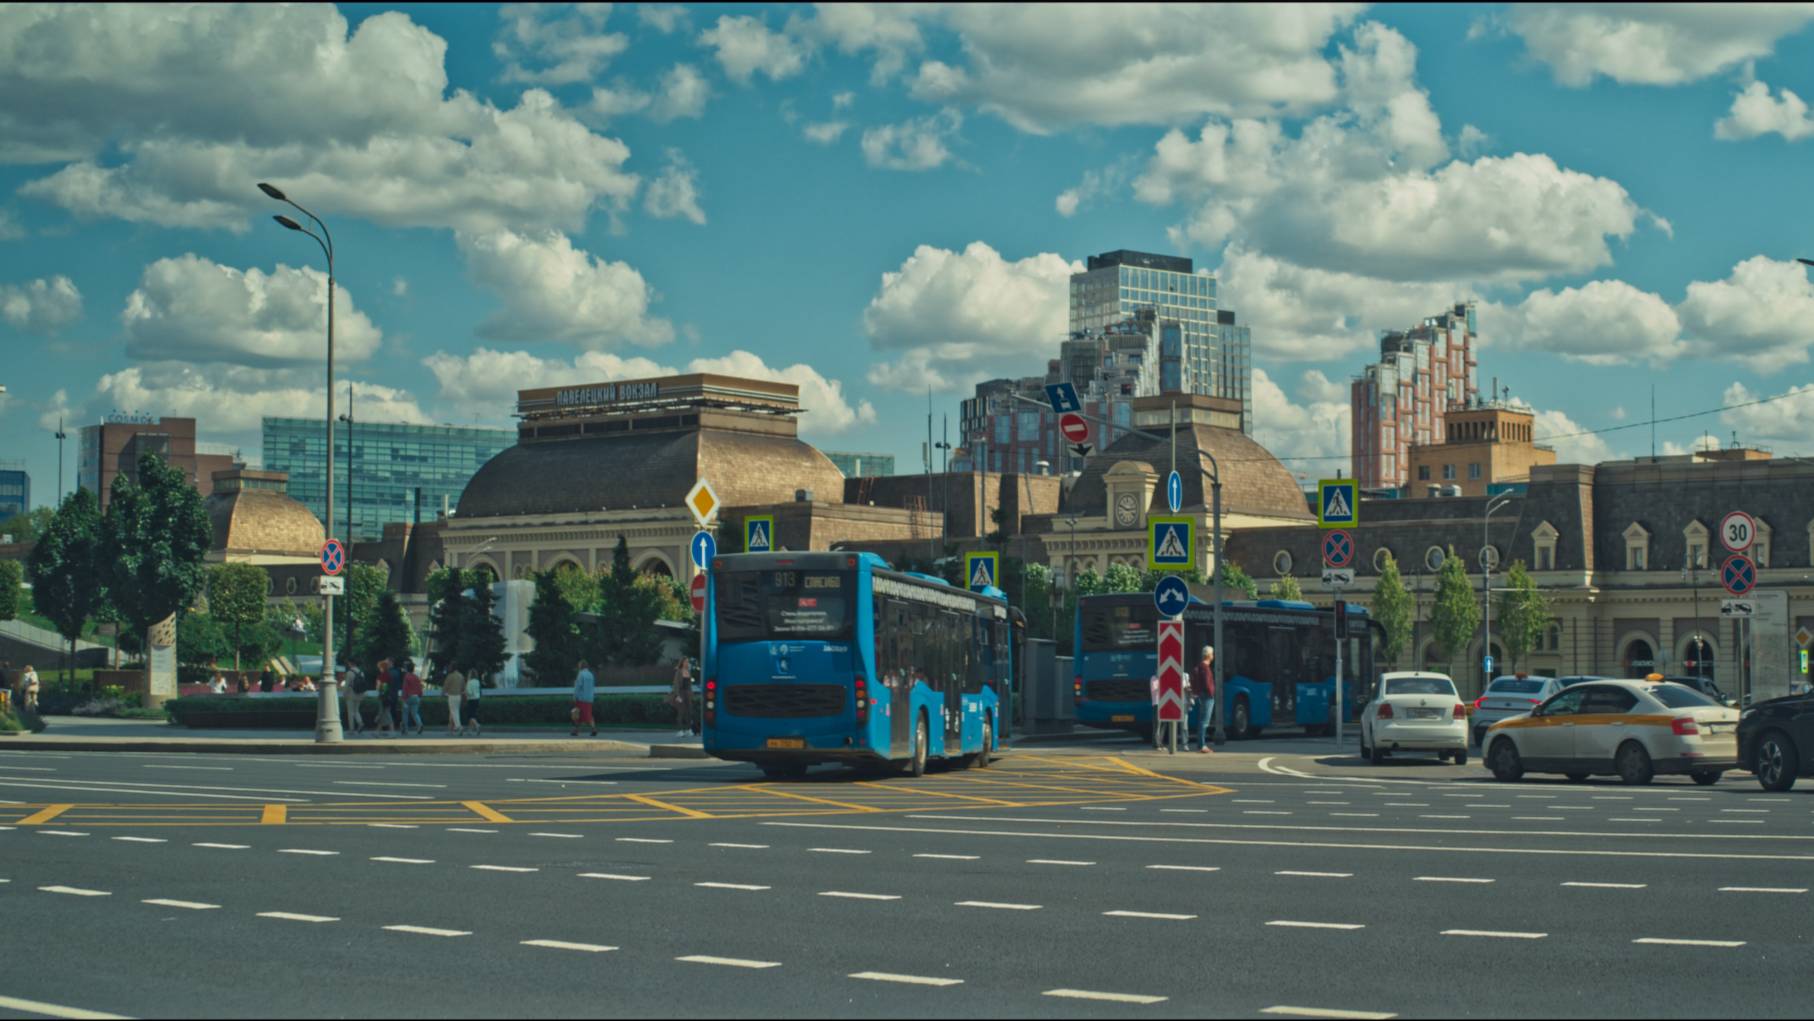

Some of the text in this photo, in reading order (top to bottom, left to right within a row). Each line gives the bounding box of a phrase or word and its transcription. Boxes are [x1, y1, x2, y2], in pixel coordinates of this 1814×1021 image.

[556, 382, 657, 406] ПАВЕЛЕЦКИЙ ВОКЗАЛ
[1729, 524, 1747, 541] 30
